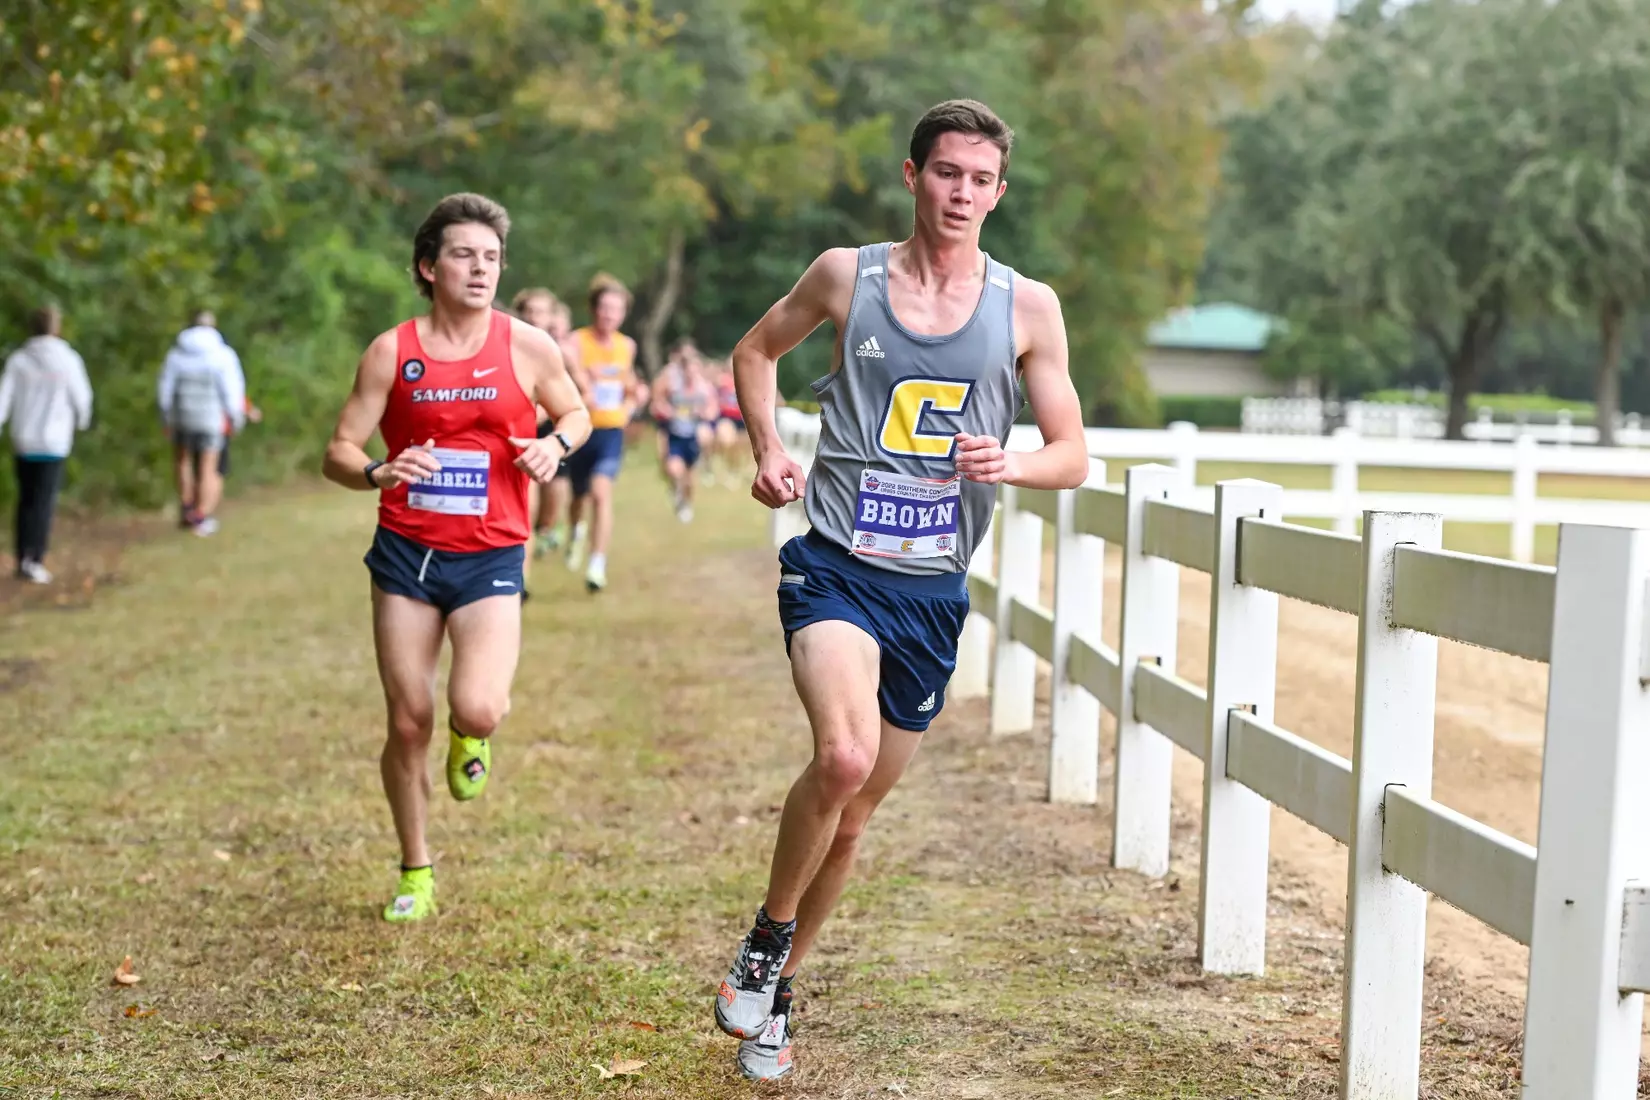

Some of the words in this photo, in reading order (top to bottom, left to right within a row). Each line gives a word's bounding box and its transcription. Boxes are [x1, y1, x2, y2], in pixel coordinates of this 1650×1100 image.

[856, 348, 885, 359] adidas
[412, 387, 497, 402] SAMFORD
[875, 374, 976, 462] C
[881, 481, 896, 490] 2022
[897, 484, 928, 494] SOUTHERN
[860, 498, 955, 529] BROWN
